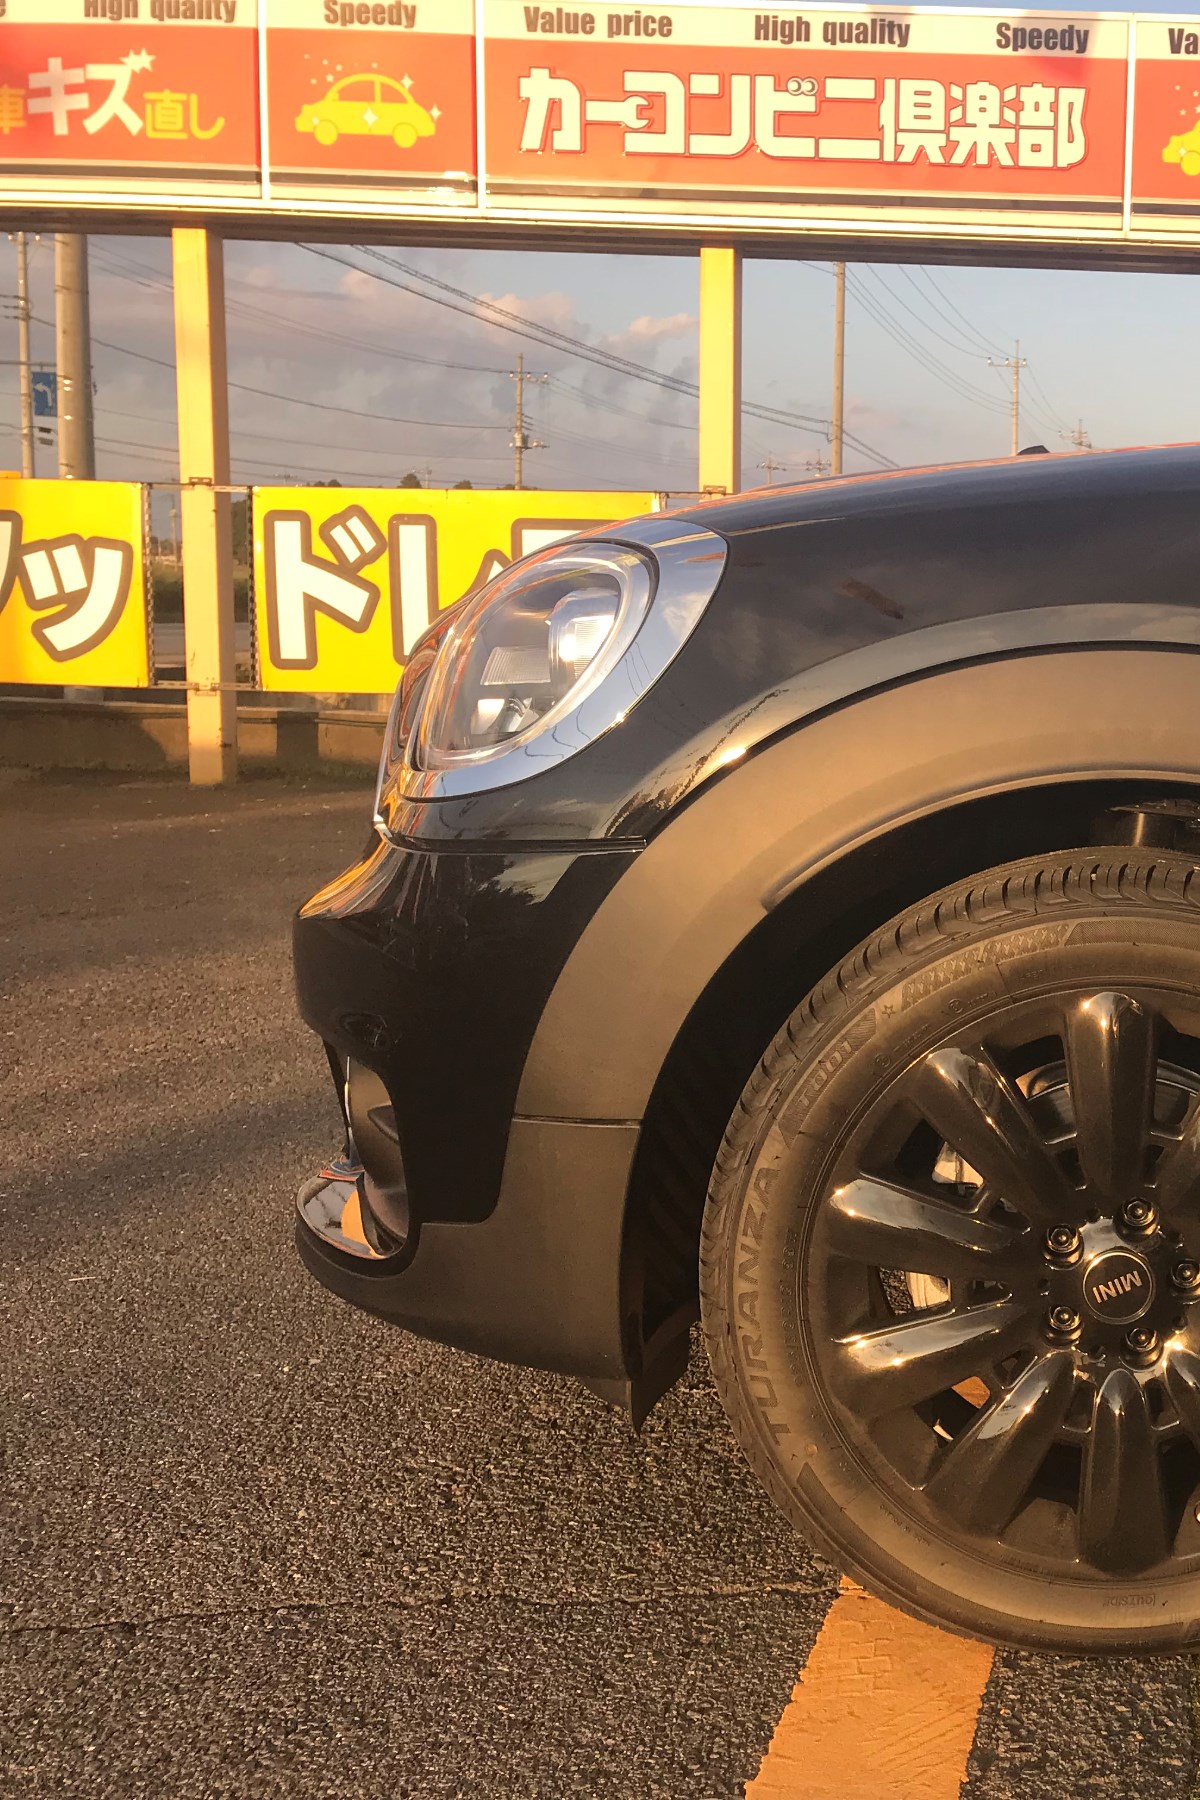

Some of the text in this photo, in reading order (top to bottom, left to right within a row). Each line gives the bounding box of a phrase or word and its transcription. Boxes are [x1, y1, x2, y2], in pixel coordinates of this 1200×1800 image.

[83, 0, 237, 23] High quality
[323, 0, 417, 29] Speedy
[524, 6, 673, 38] Value price
[754, 15, 910, 48] High quality
[996, 22, 1089, 54] Speedy
[518, 66, 1090, 170] カーコンビニ倶楽部
[263, 505, 622, 670] ドレ
[1092, 1270, 1143, 1304] MINI
[738, 1166, 793, 1447] TURANZA
